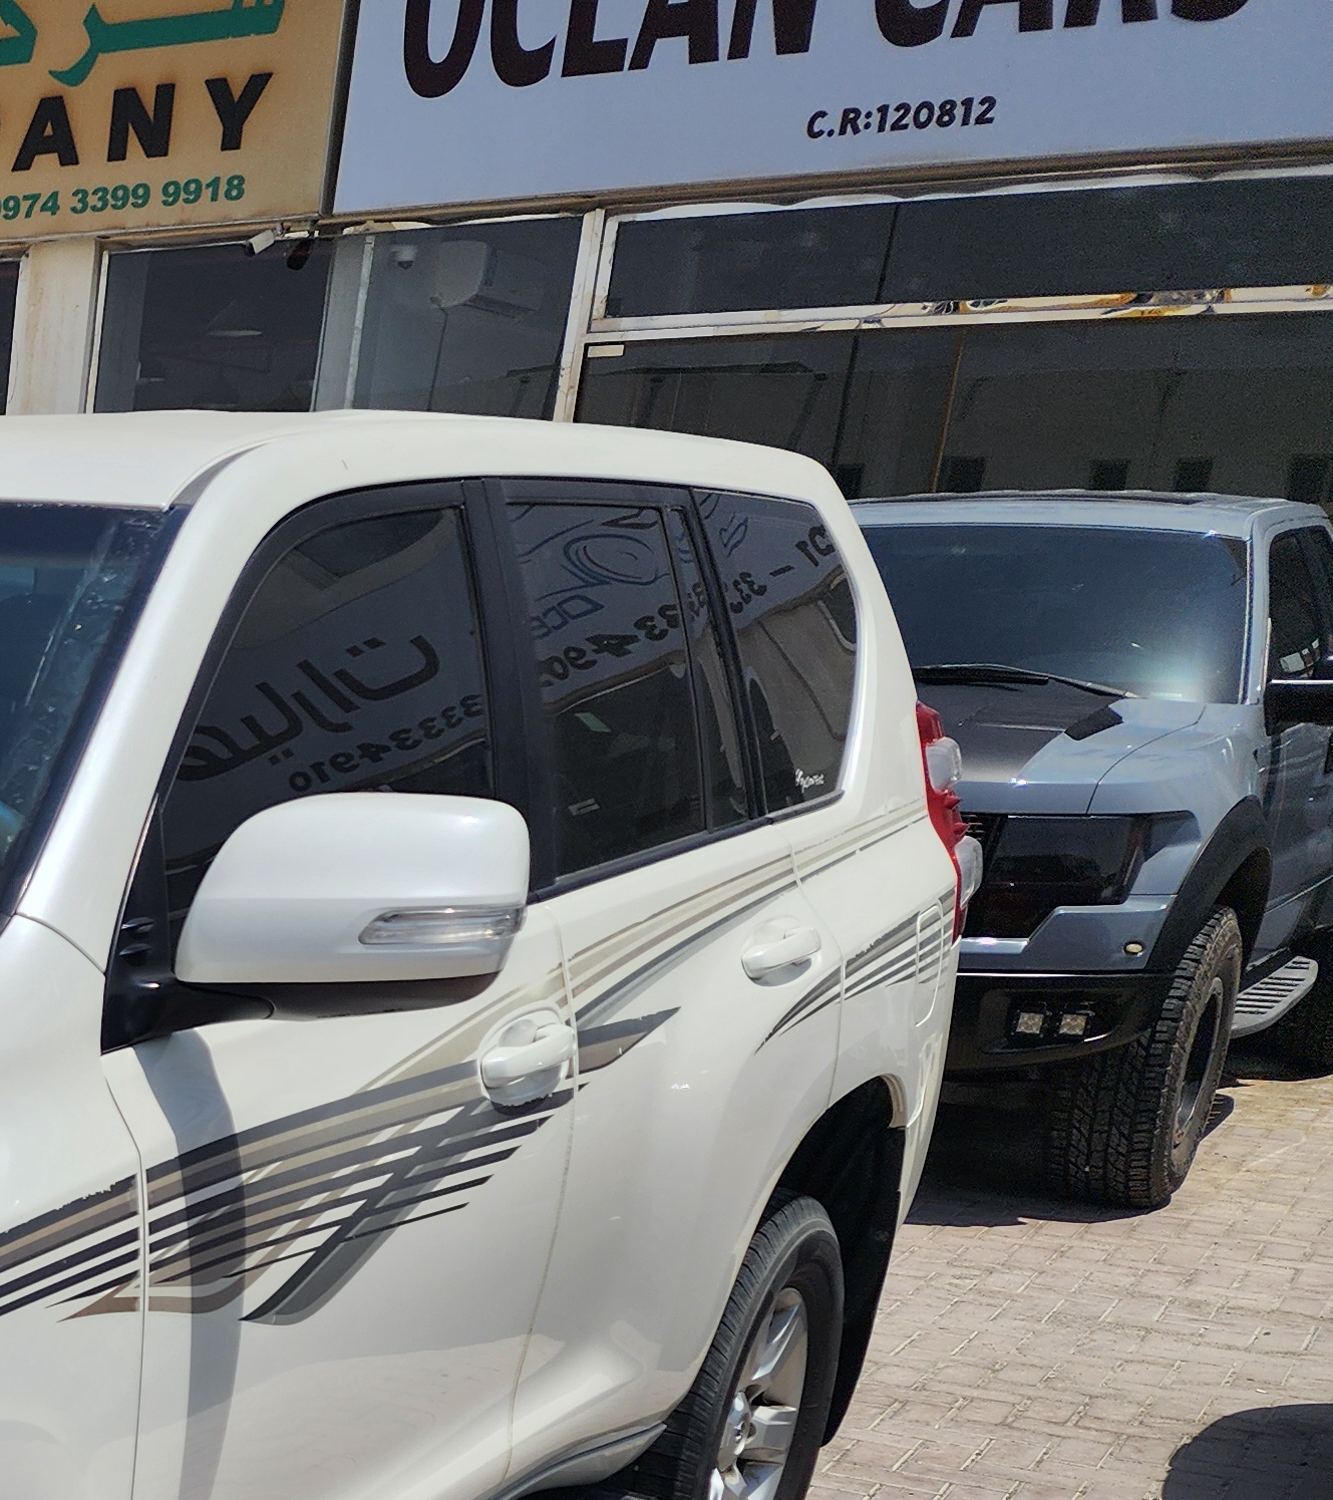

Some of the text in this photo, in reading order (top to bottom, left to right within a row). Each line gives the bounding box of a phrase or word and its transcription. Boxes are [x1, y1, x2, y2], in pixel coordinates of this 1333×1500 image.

[807, 96, 997, 139] C.R:120812
[70, 182, 152, 214] 3399
[161, 174, 247, 207] 9918
